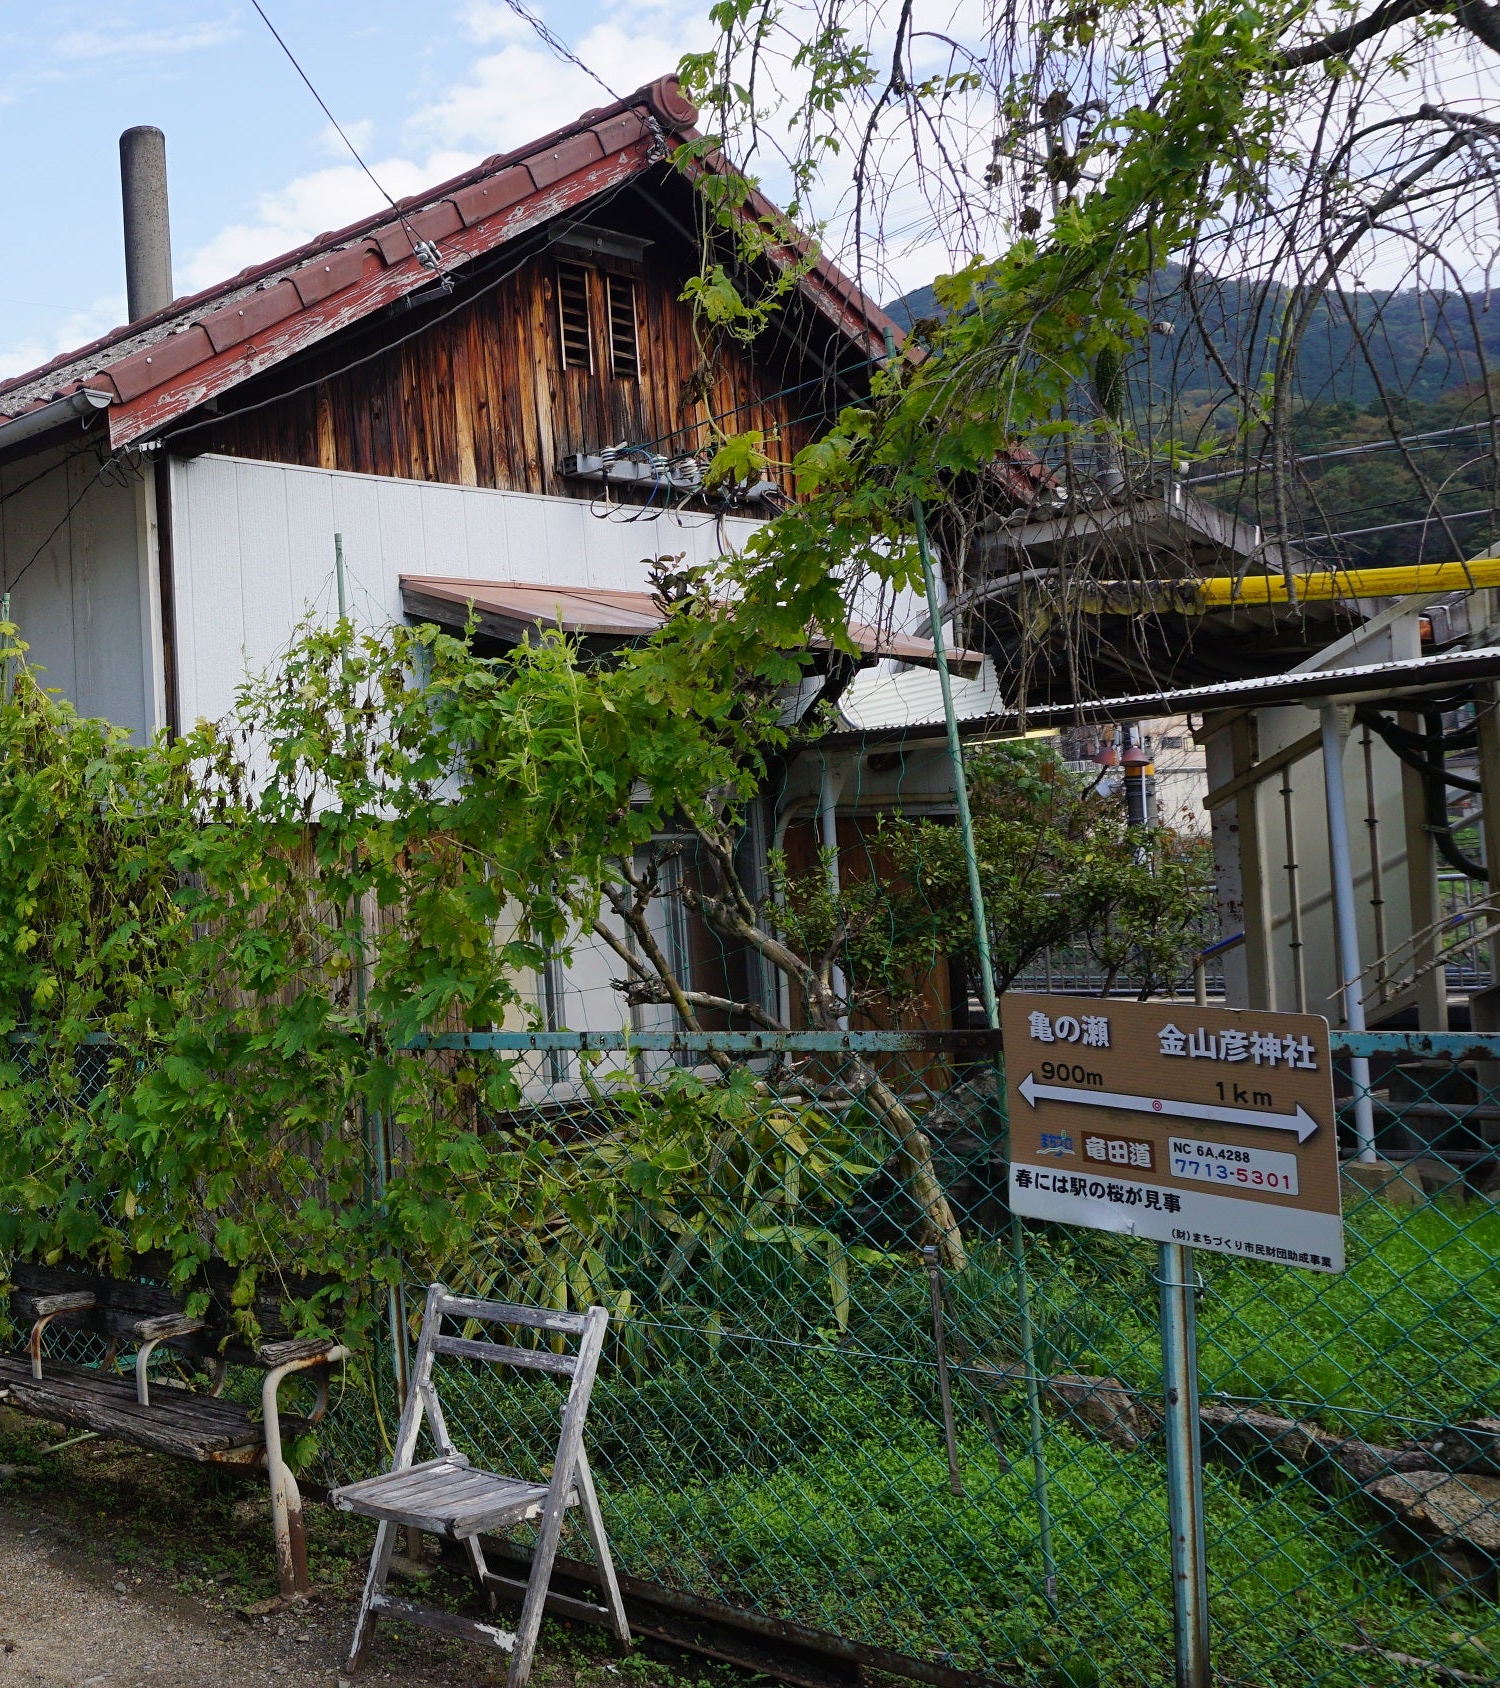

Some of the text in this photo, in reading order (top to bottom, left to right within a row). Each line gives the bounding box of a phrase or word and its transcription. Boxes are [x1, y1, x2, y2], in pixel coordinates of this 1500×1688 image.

[1028, 1011, 1317, 1070] 亀の瀬 金山彦神社
[1041, 1061, 1272, 1107] 900m 1km
[1085, 1136, 1152, 1168] 竜田道
[1173, 1142, 1192, 1155] NC
[1015, 1169, 1181, 1213] 春には駅の桜が見事
[1175, 1158, 1290, 1190] 7713-5301
